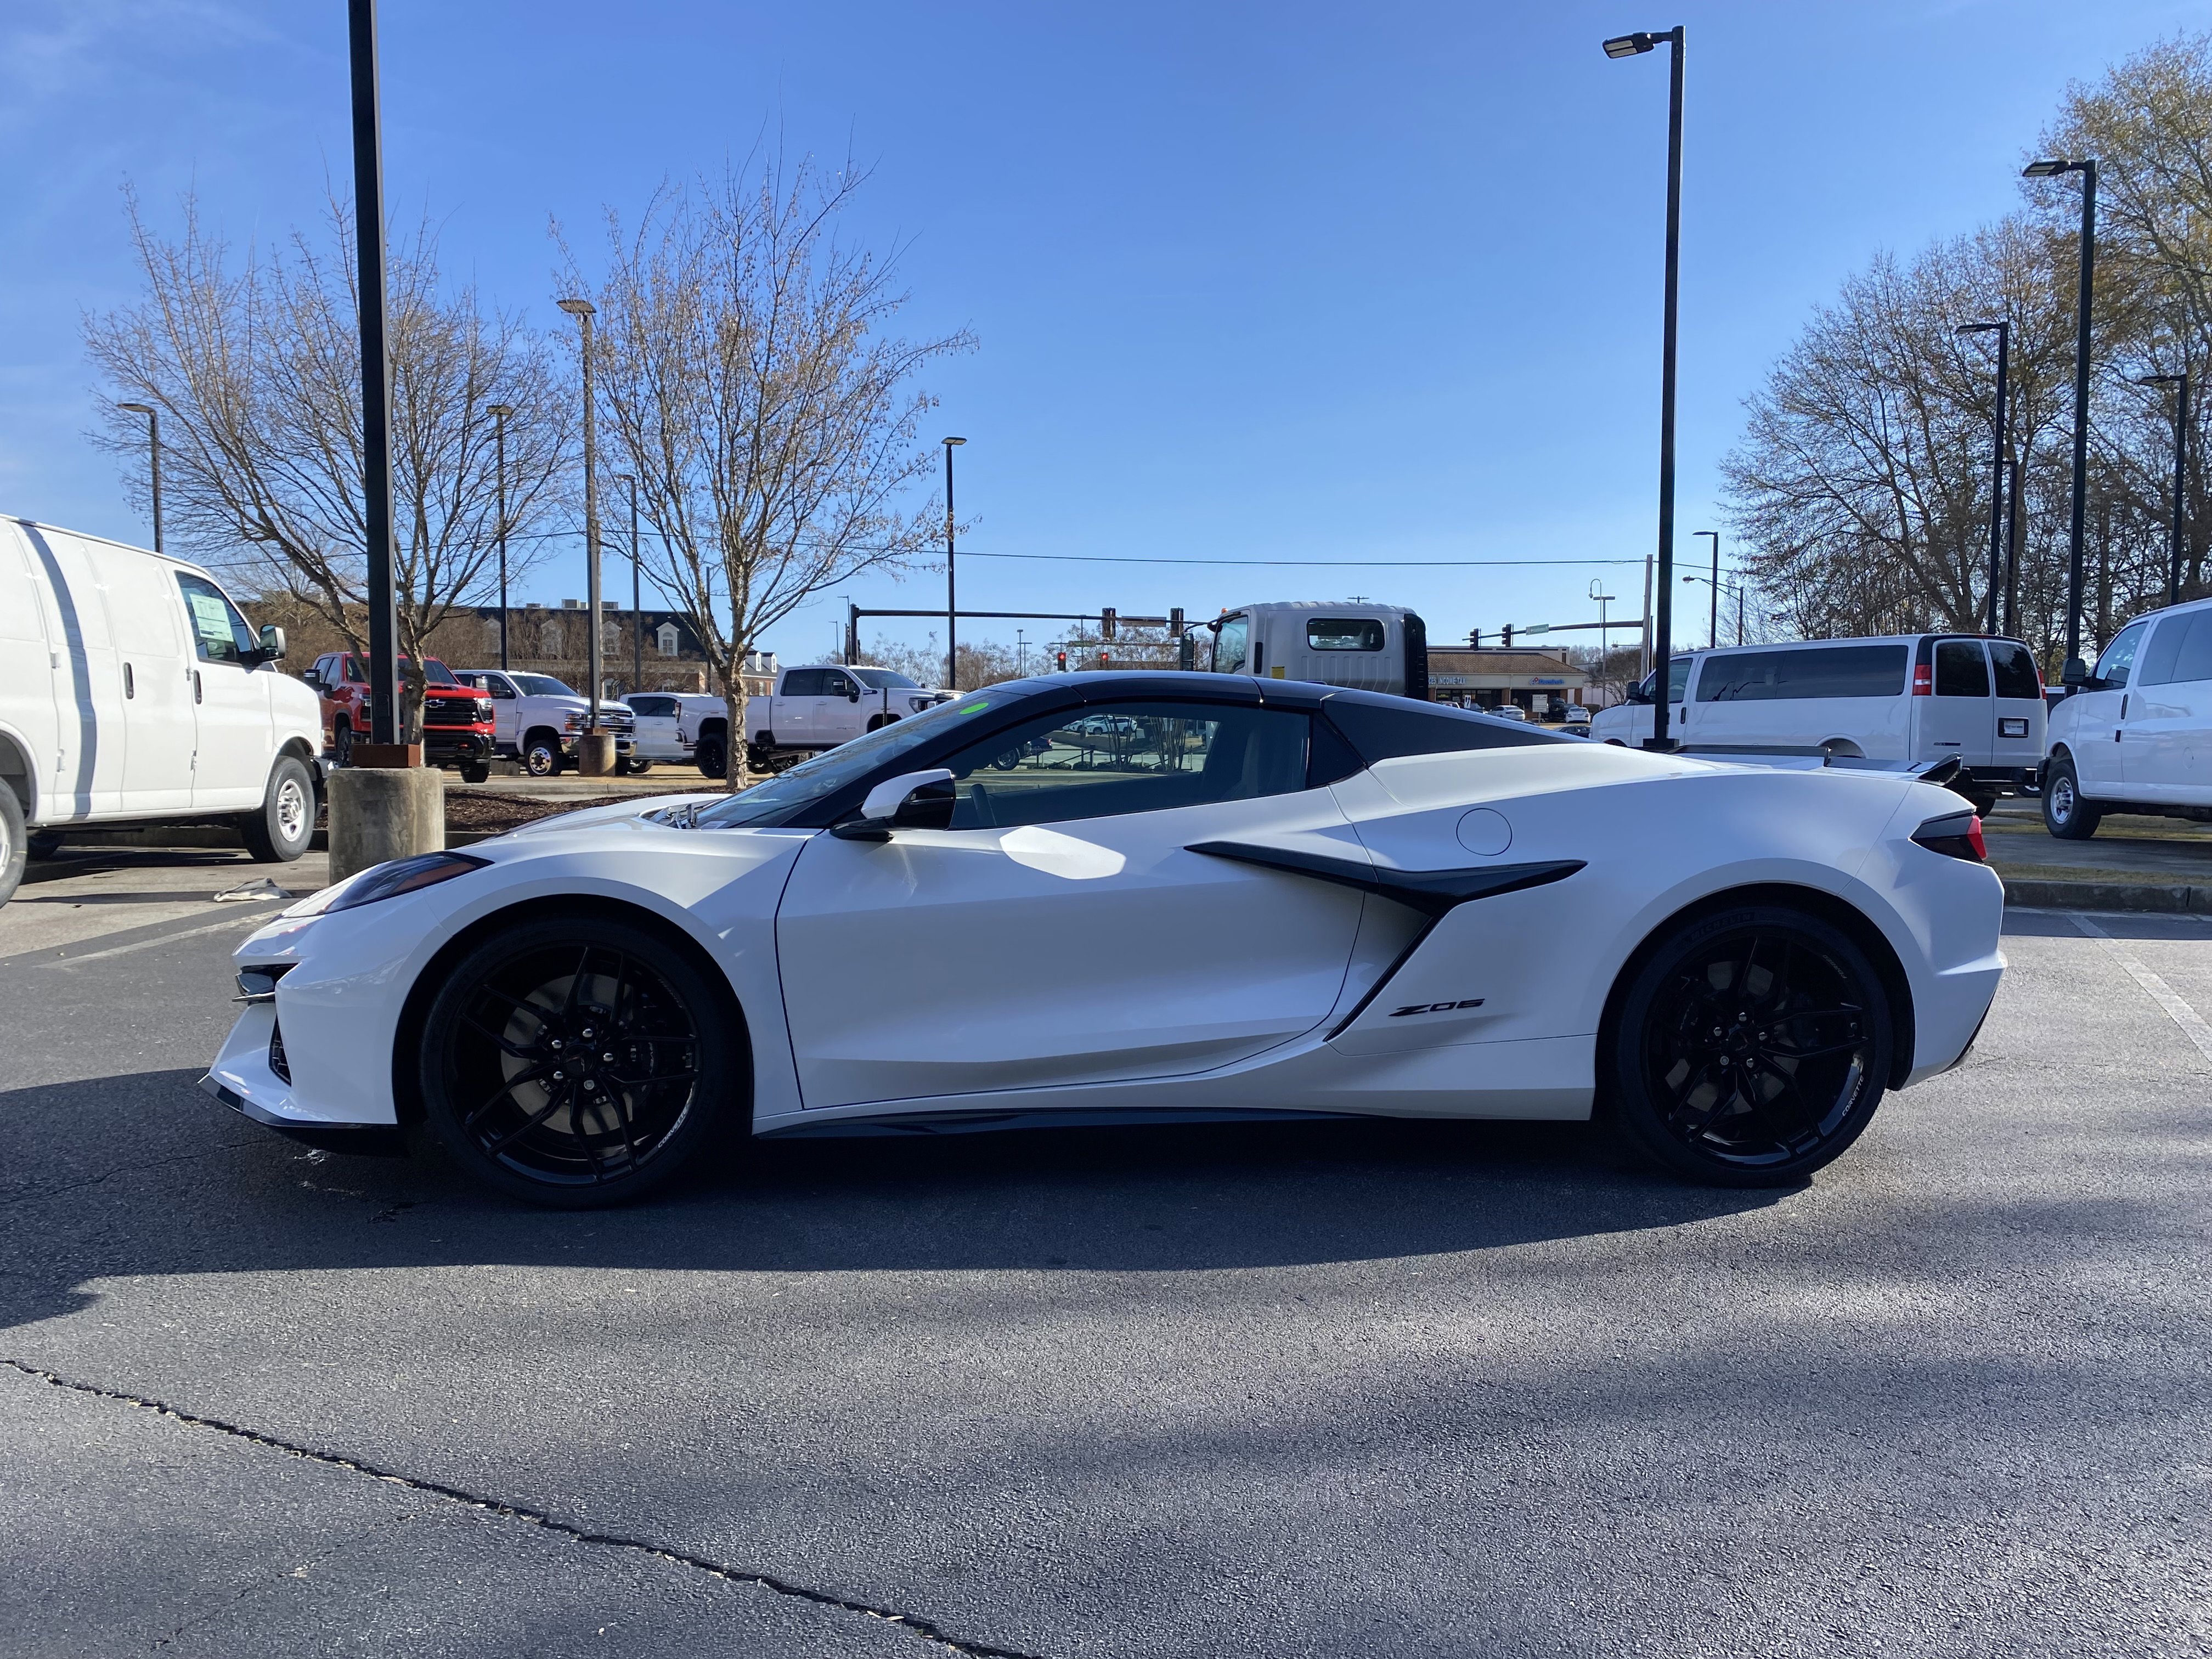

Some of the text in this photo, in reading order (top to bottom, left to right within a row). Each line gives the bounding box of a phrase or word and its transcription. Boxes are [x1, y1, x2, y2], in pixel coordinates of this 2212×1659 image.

[1388, 998, 1485, 1016] Z06
[1842, 1075, 1864, 1116] CORVETTE
[658, 1105, 687, 1148] CORVETTE
